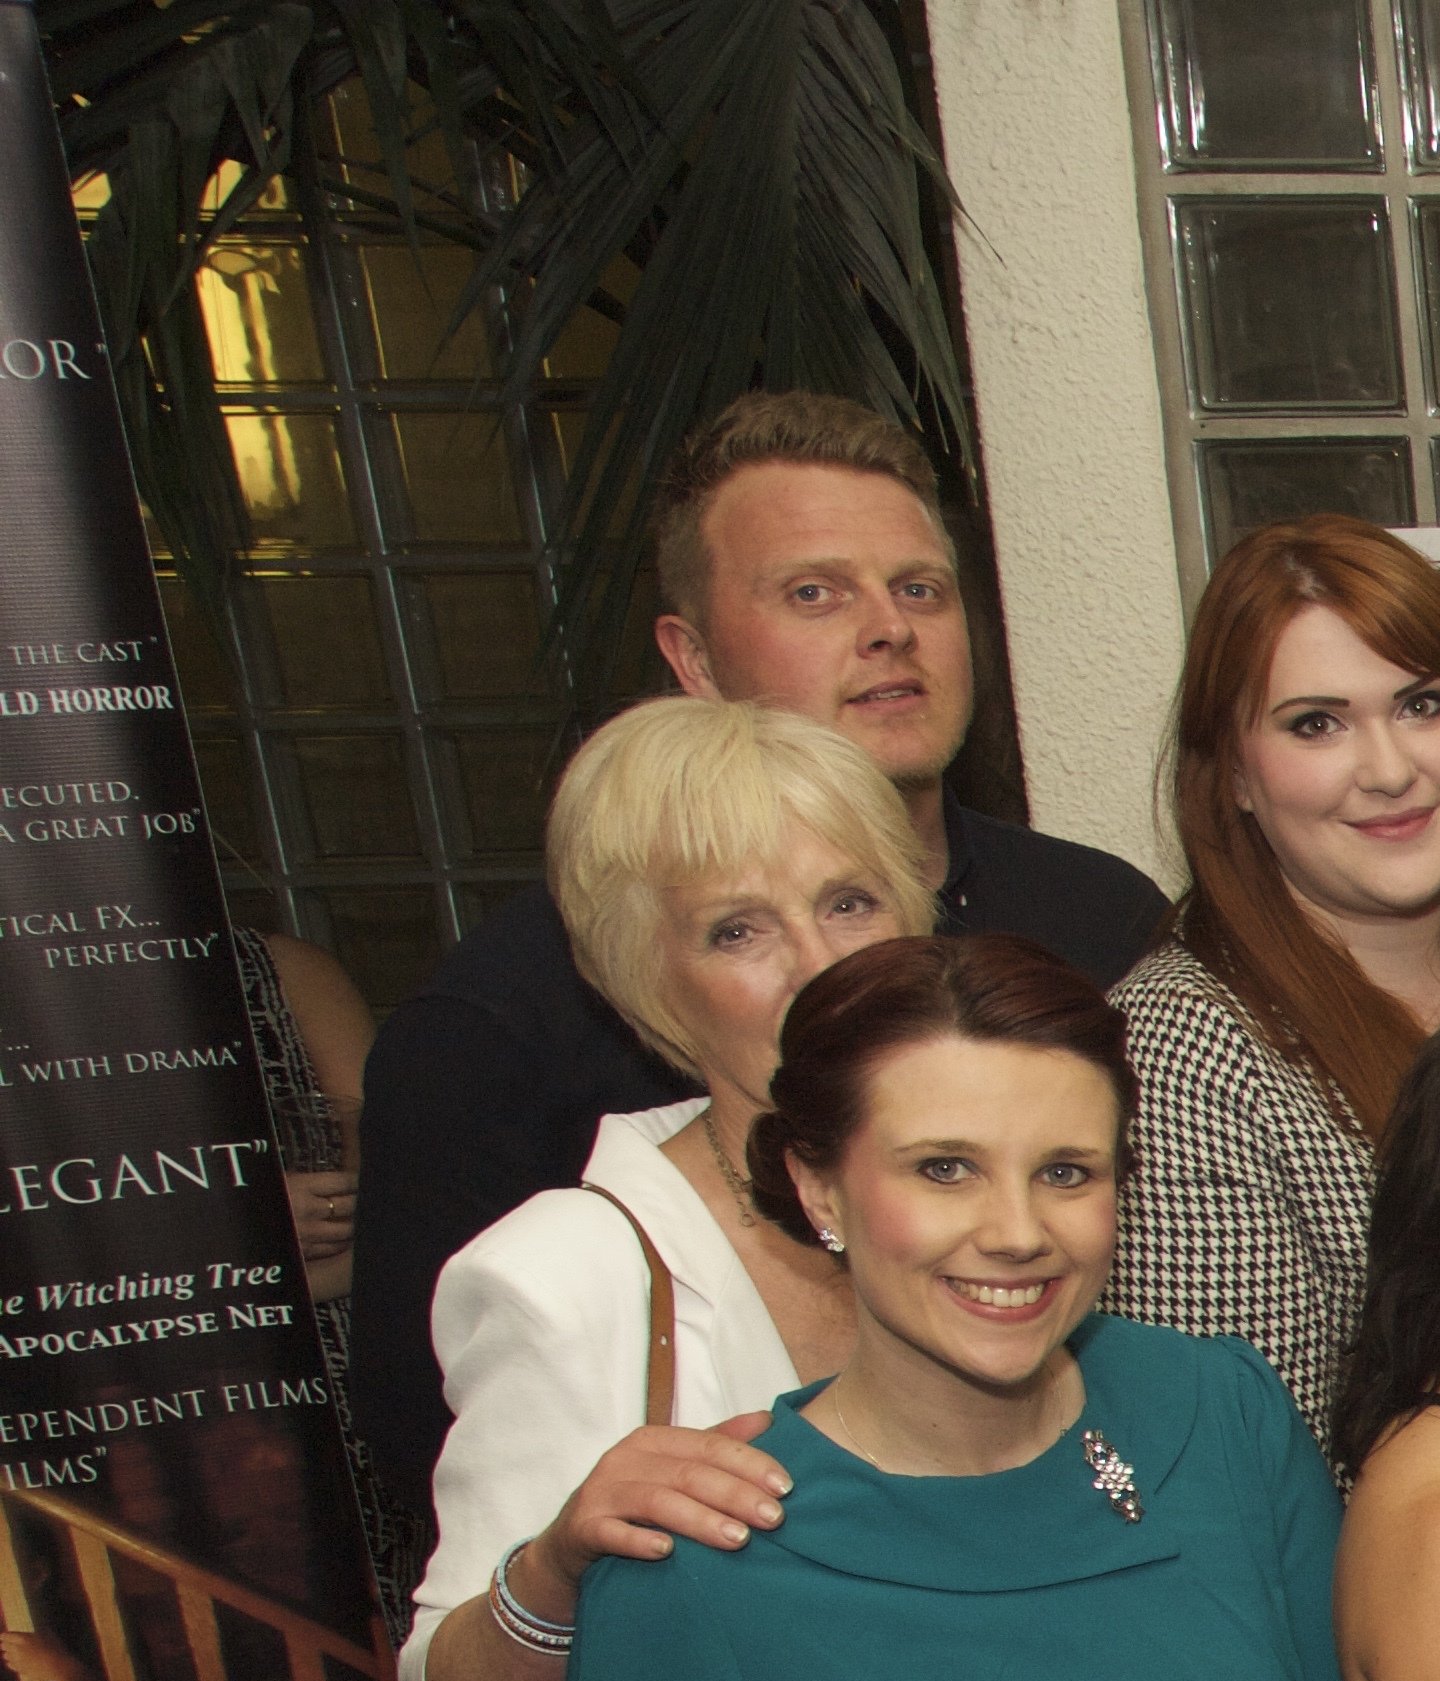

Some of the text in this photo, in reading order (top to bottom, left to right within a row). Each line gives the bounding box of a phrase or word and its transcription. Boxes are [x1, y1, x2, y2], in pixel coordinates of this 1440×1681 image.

[0, 339, 92, 380] OR
[8, 644, 68, 666] THE
[48, 685, 174, 714] HORROR
[25, 815, 129, 842] GREAT
[97, 904, 160, 930] FX...
[22, 1055, 111, 1083] WITH
[36, 1262, 283, 1312] Witching Tree
[221, 1376, 328, 1413] FILMS
